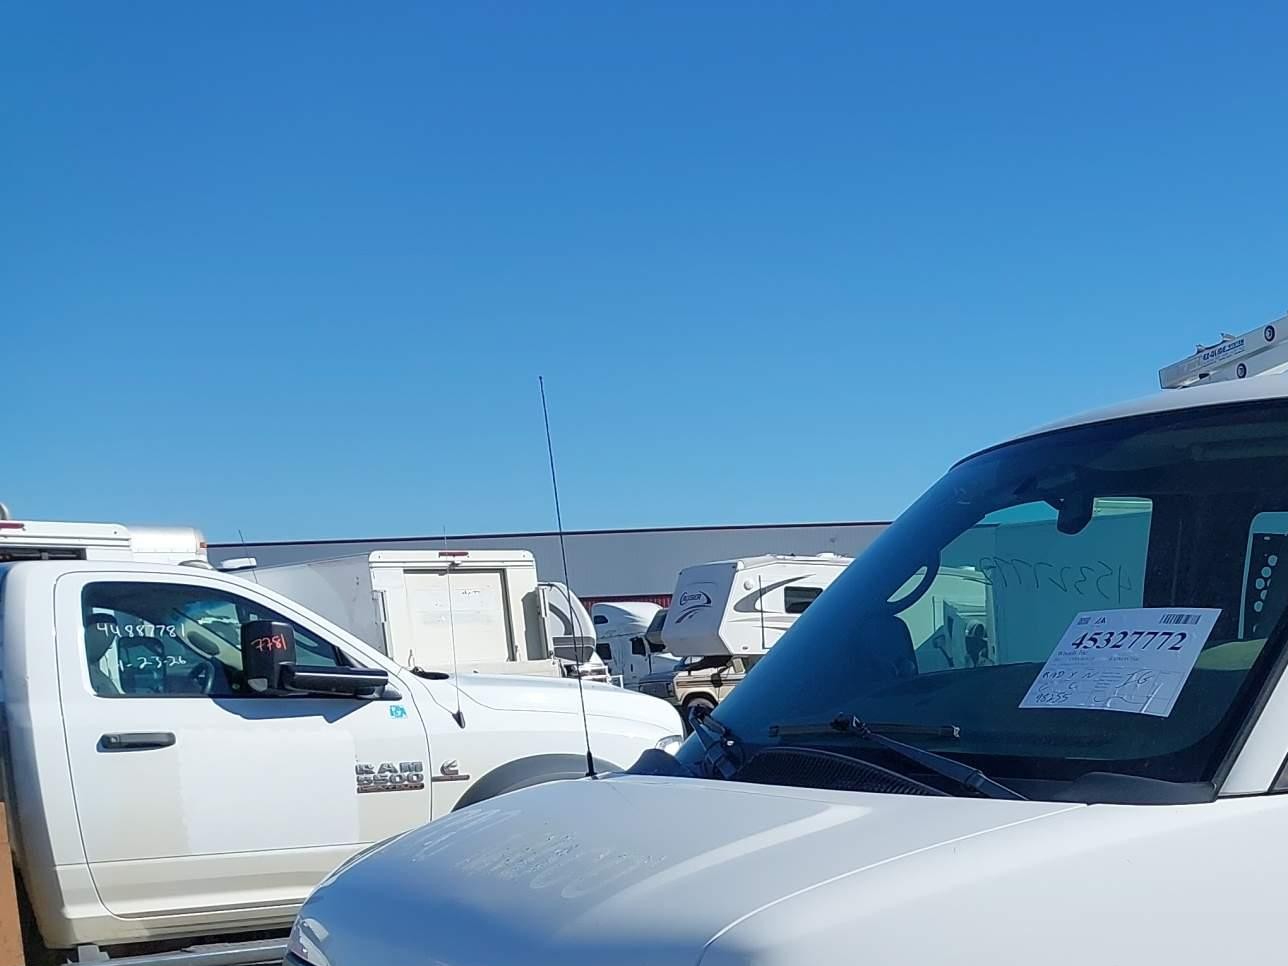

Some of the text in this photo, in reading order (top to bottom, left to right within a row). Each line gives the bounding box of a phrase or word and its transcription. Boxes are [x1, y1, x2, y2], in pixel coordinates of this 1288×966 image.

[1072, 631, 1187, 651] 45327772
[355, 761, 424, 775] RAM
[356, 773, 424, 785] 5500
